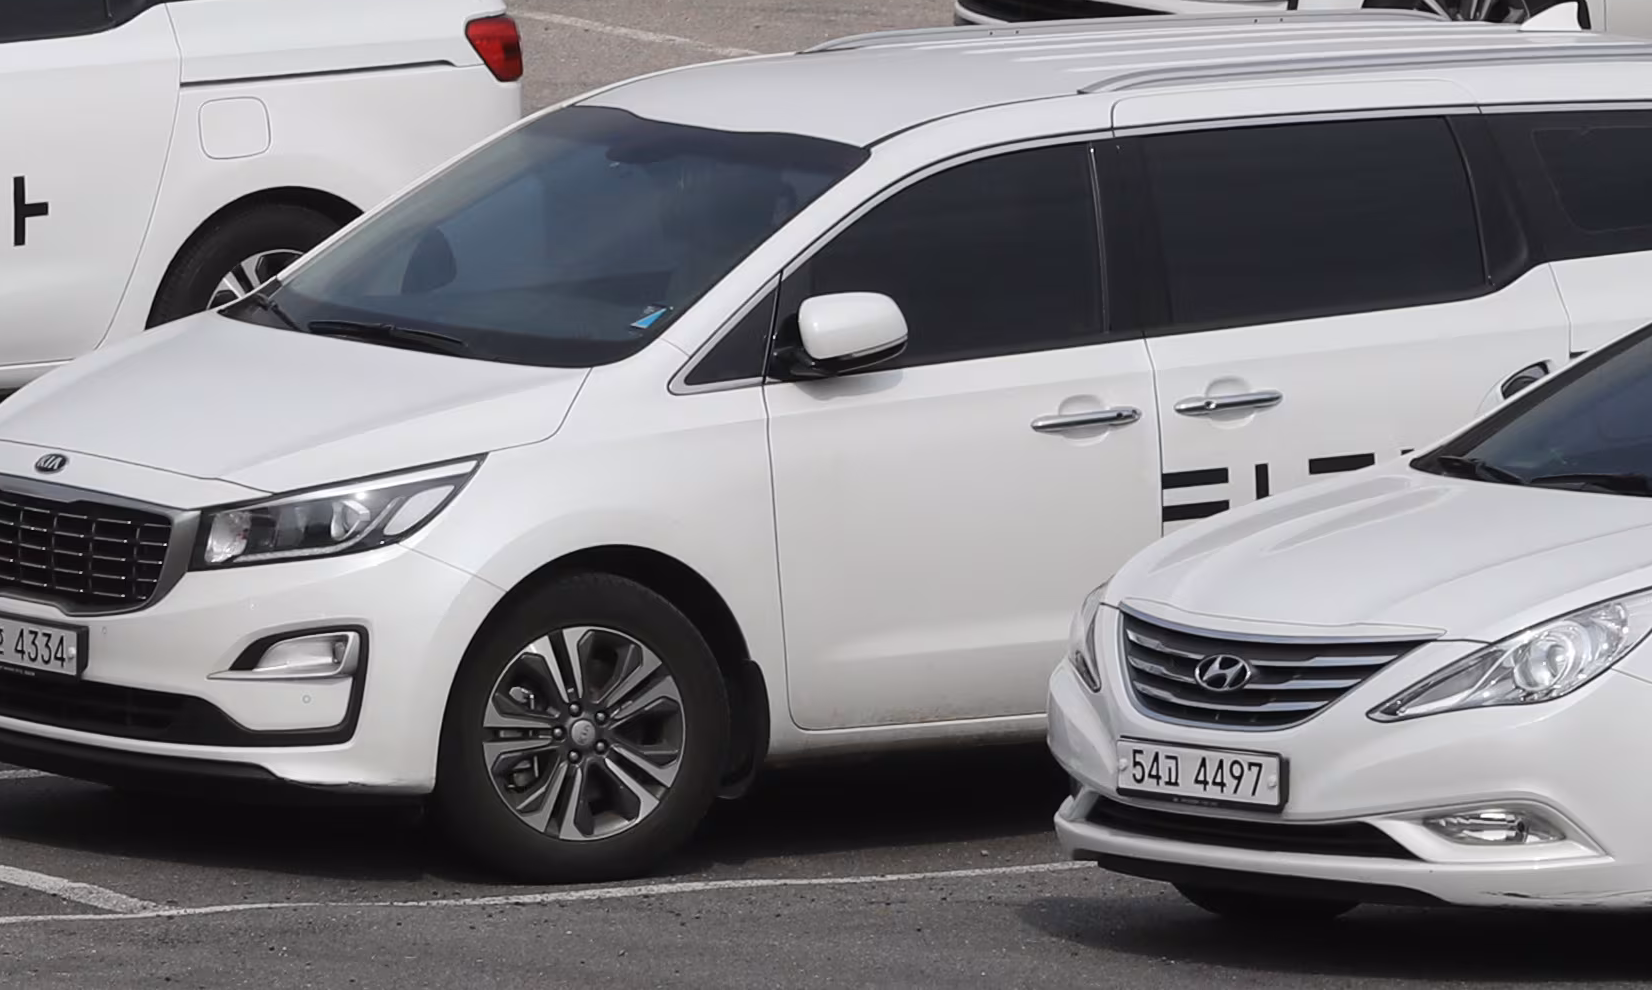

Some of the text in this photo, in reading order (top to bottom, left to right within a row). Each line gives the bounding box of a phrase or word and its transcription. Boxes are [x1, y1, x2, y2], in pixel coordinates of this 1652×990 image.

[14, 628, 66, 668] 4334
[1132, 748, 1263, 797] 54고 4497
